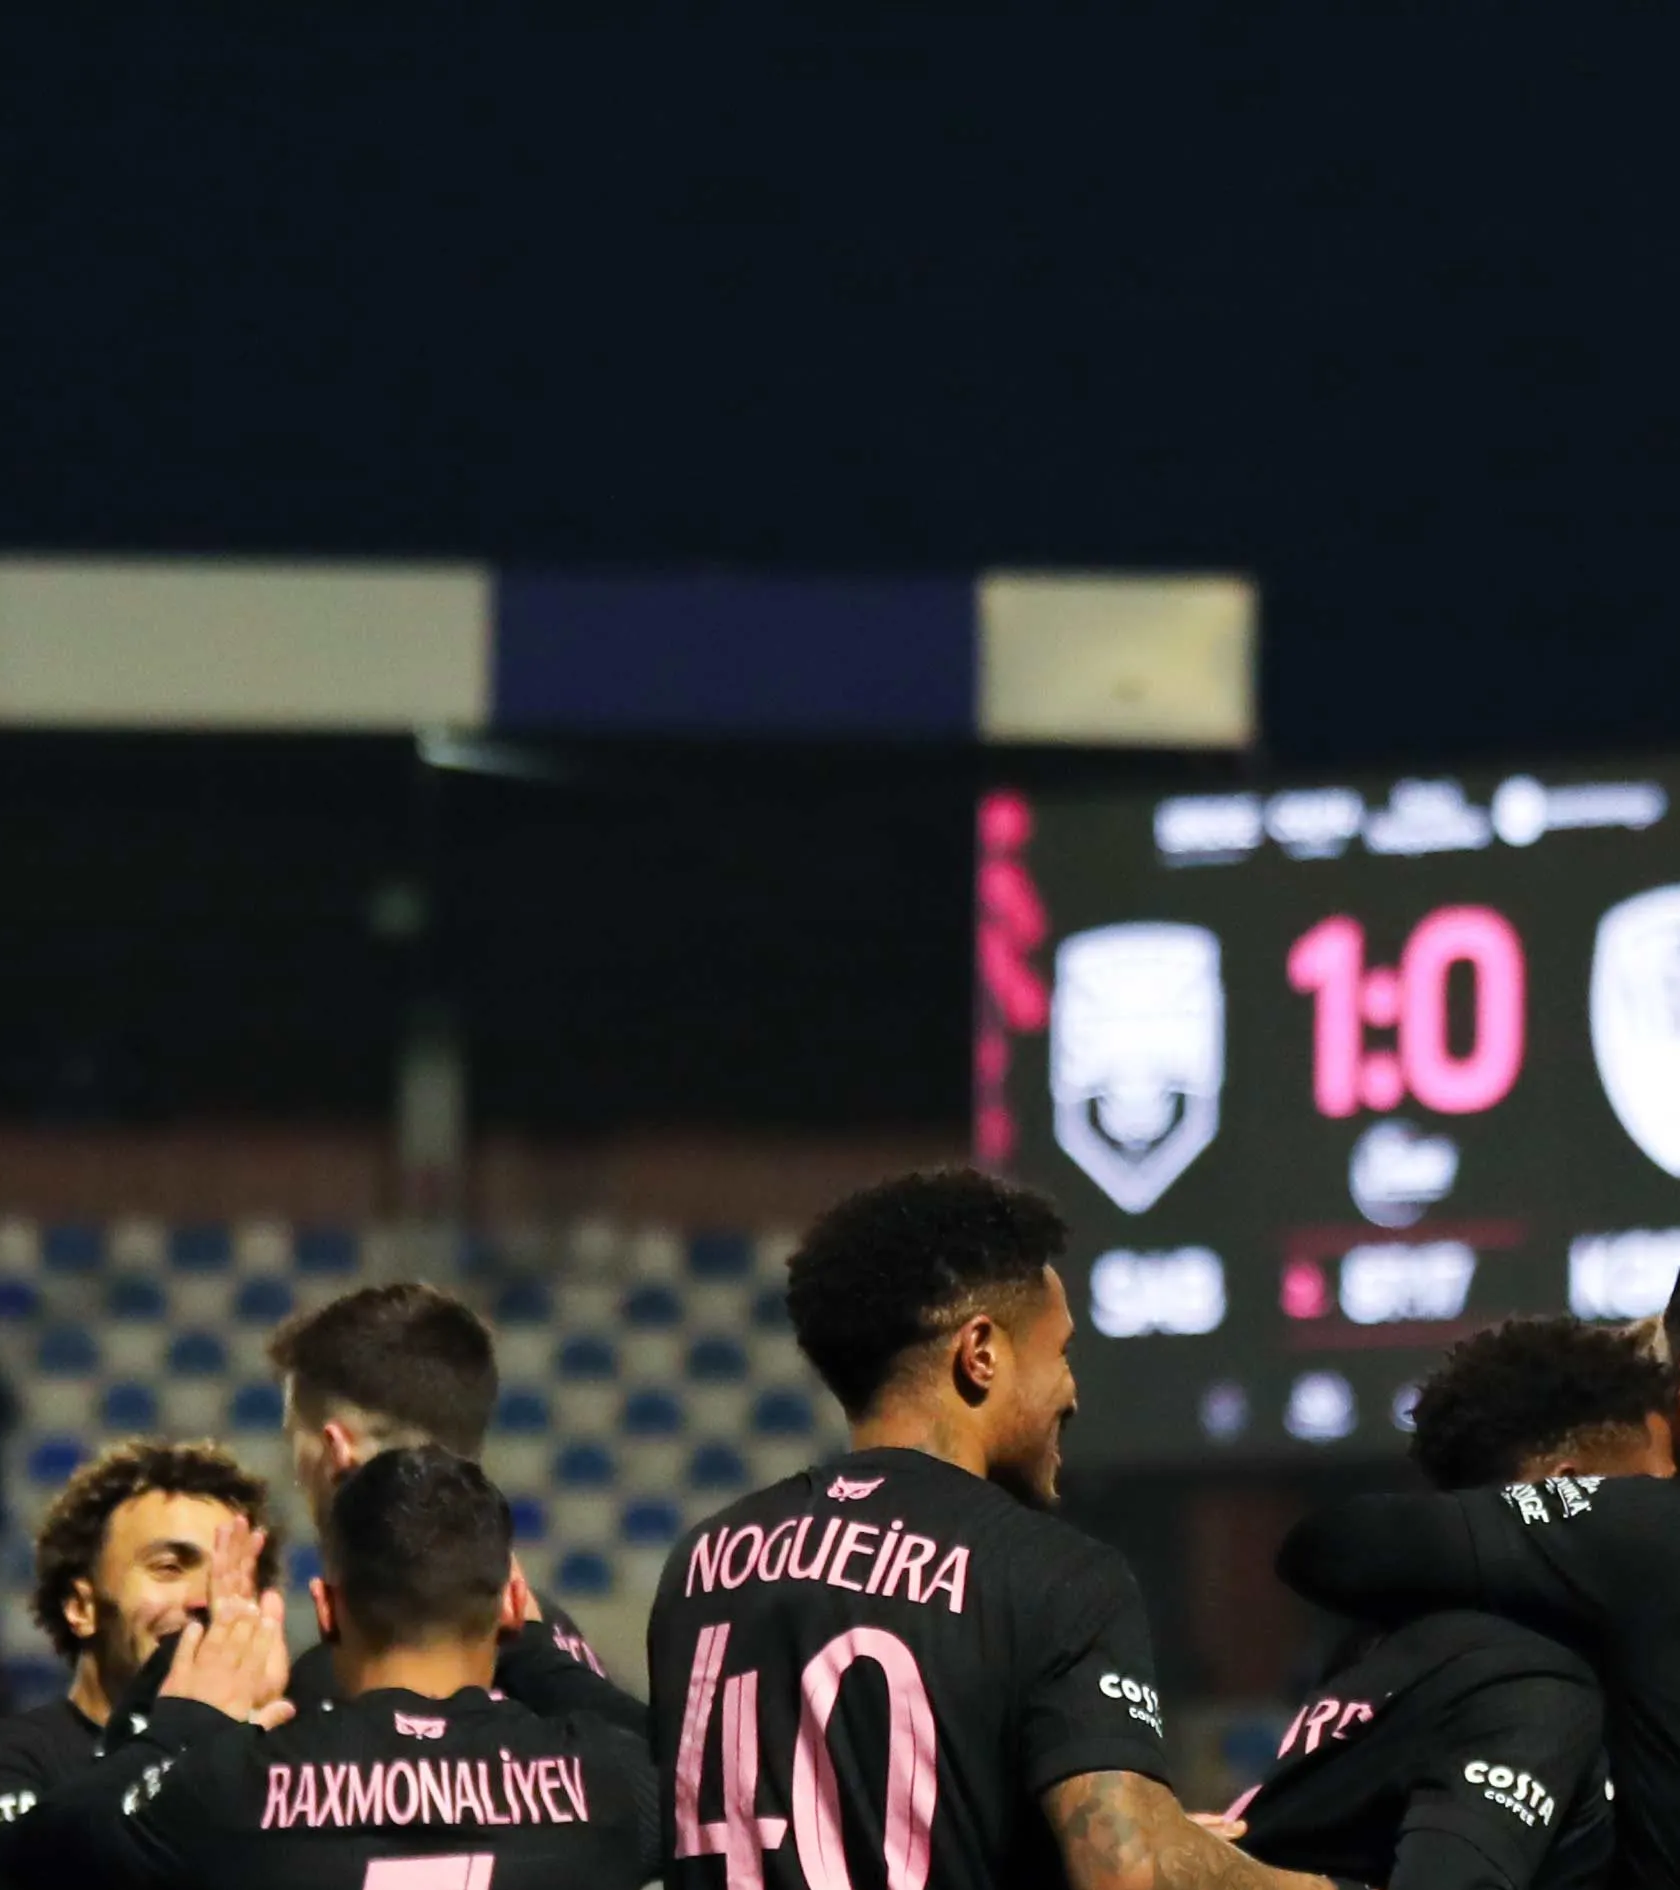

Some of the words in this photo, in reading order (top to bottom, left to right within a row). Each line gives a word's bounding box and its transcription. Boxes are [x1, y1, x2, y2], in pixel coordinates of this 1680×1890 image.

[1286, 904, 1527, 1119] 1:0
[1463, 1760, 1555, 1826] COSTA
[1484, 1790, 1536, 1827] COFFEE
